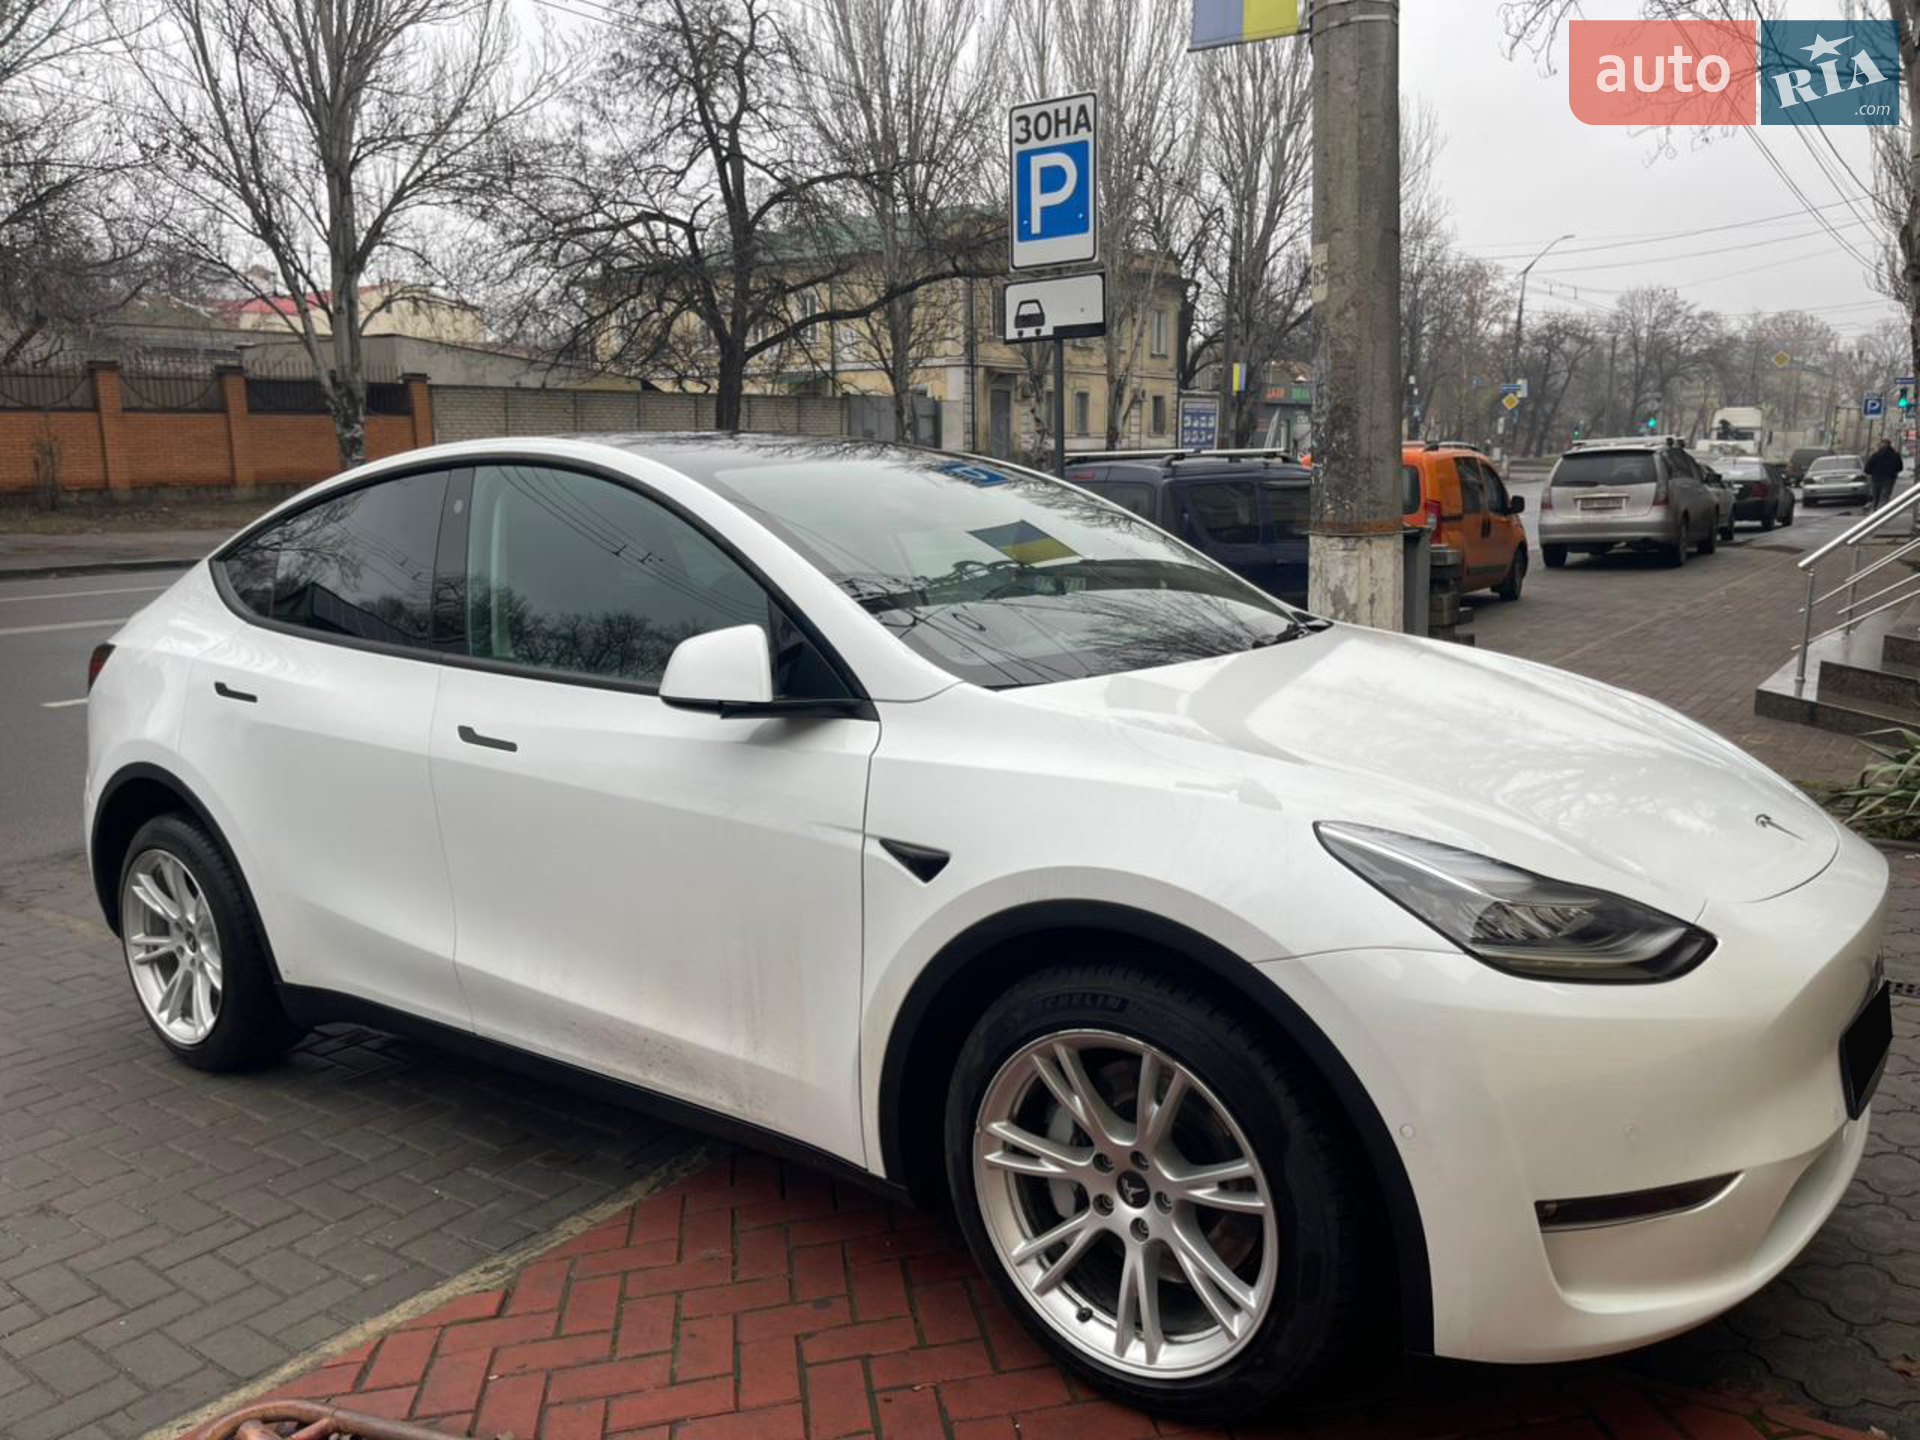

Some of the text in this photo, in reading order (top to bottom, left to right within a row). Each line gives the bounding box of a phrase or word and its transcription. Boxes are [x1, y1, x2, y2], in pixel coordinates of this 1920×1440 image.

[1014, 103, 1092, 145] ЗОНА
[1030, 152, 1078, 235] P
[1866, 399, 1880, 414] P
